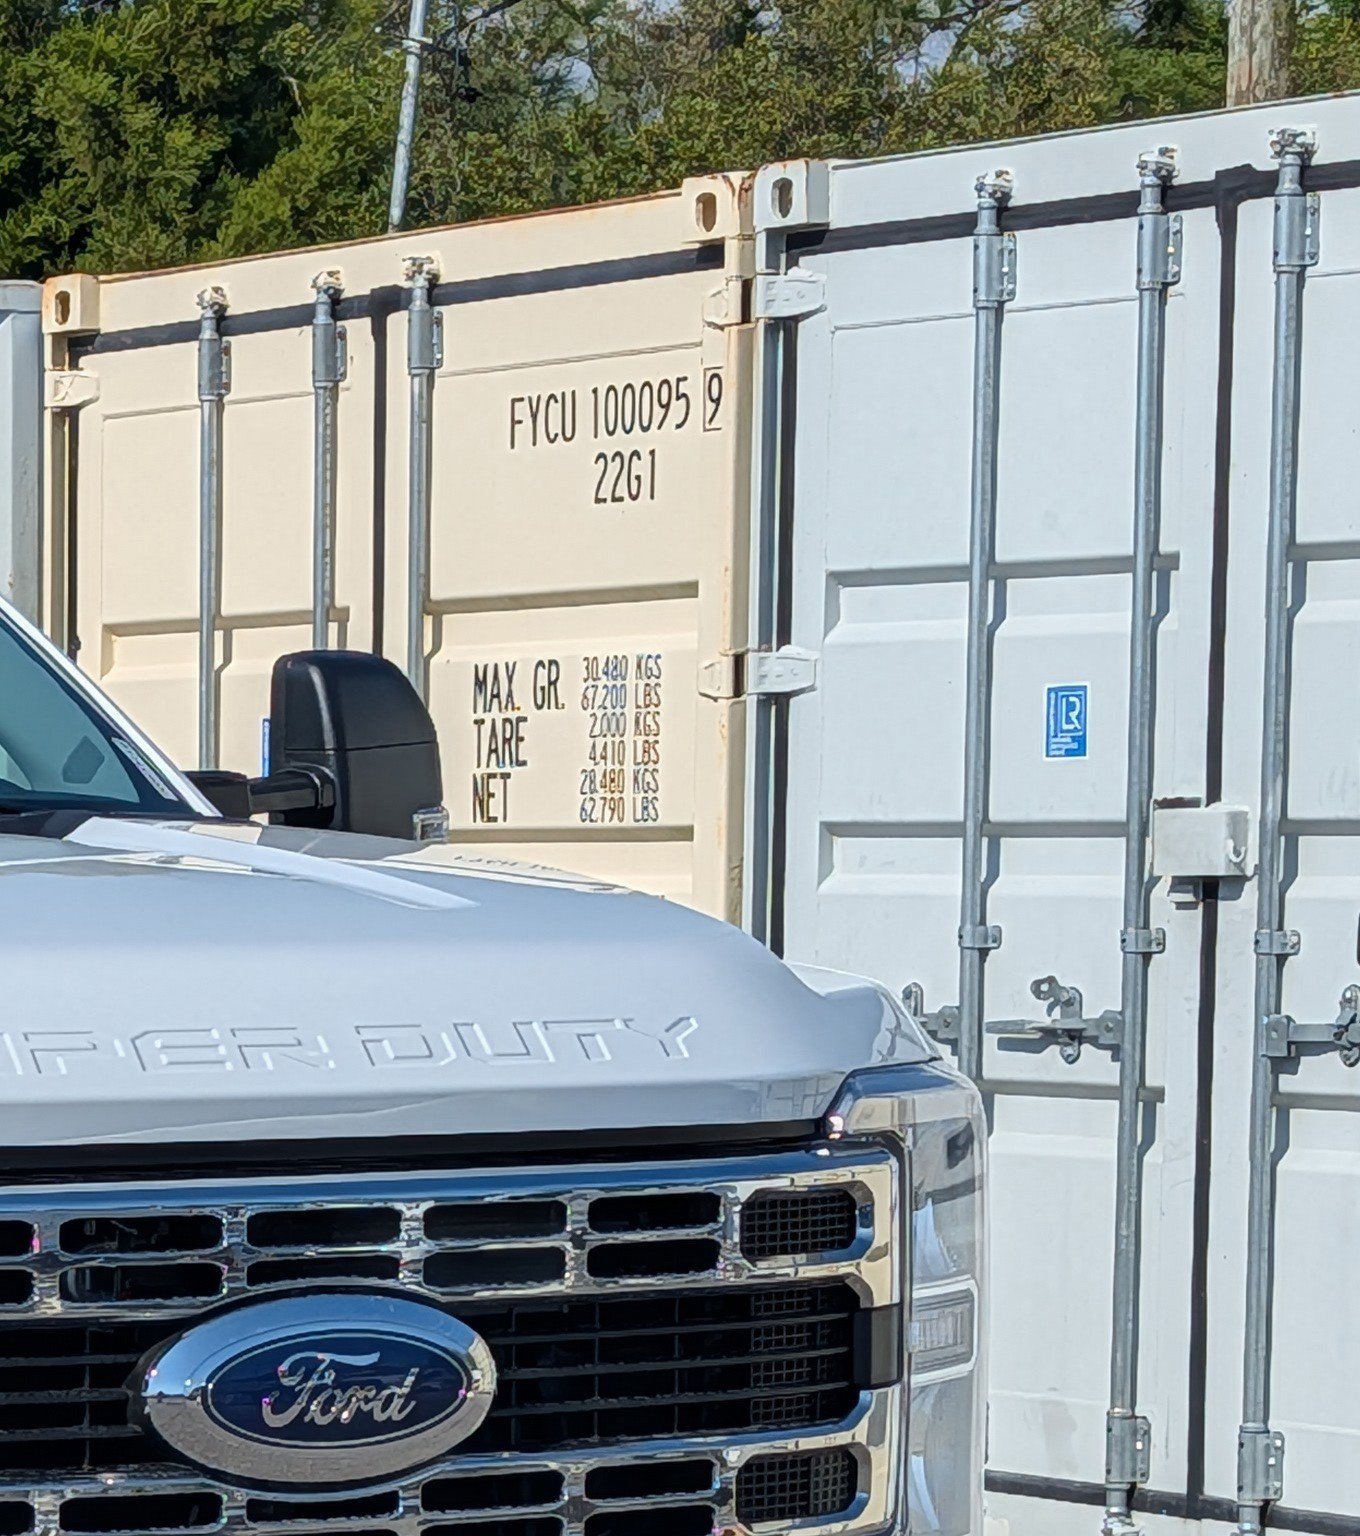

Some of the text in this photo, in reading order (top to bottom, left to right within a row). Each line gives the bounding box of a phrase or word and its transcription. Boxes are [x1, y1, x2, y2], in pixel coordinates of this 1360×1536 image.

[510, 372, 724, 450] FYCU 100095 9
[593, 449, 656, 504] 22G1
[473, 658, 566, 714] MAX. GR.
[634, 653, 662, 681] KGS
[634, 682, 662, 710] LBS
[473, 716, 529, 769] TARE
[633, 711, 661, 738] KGS
[633, 739, 660, 767] LBS
[473, 772, 512, 824] NET
[632, 768, 660, 795] KGS
[632, 796, 660, 823] LBS
[354, 1016, 699, 1067] DUTY
[261, 1350, 421, 1428] Ford
